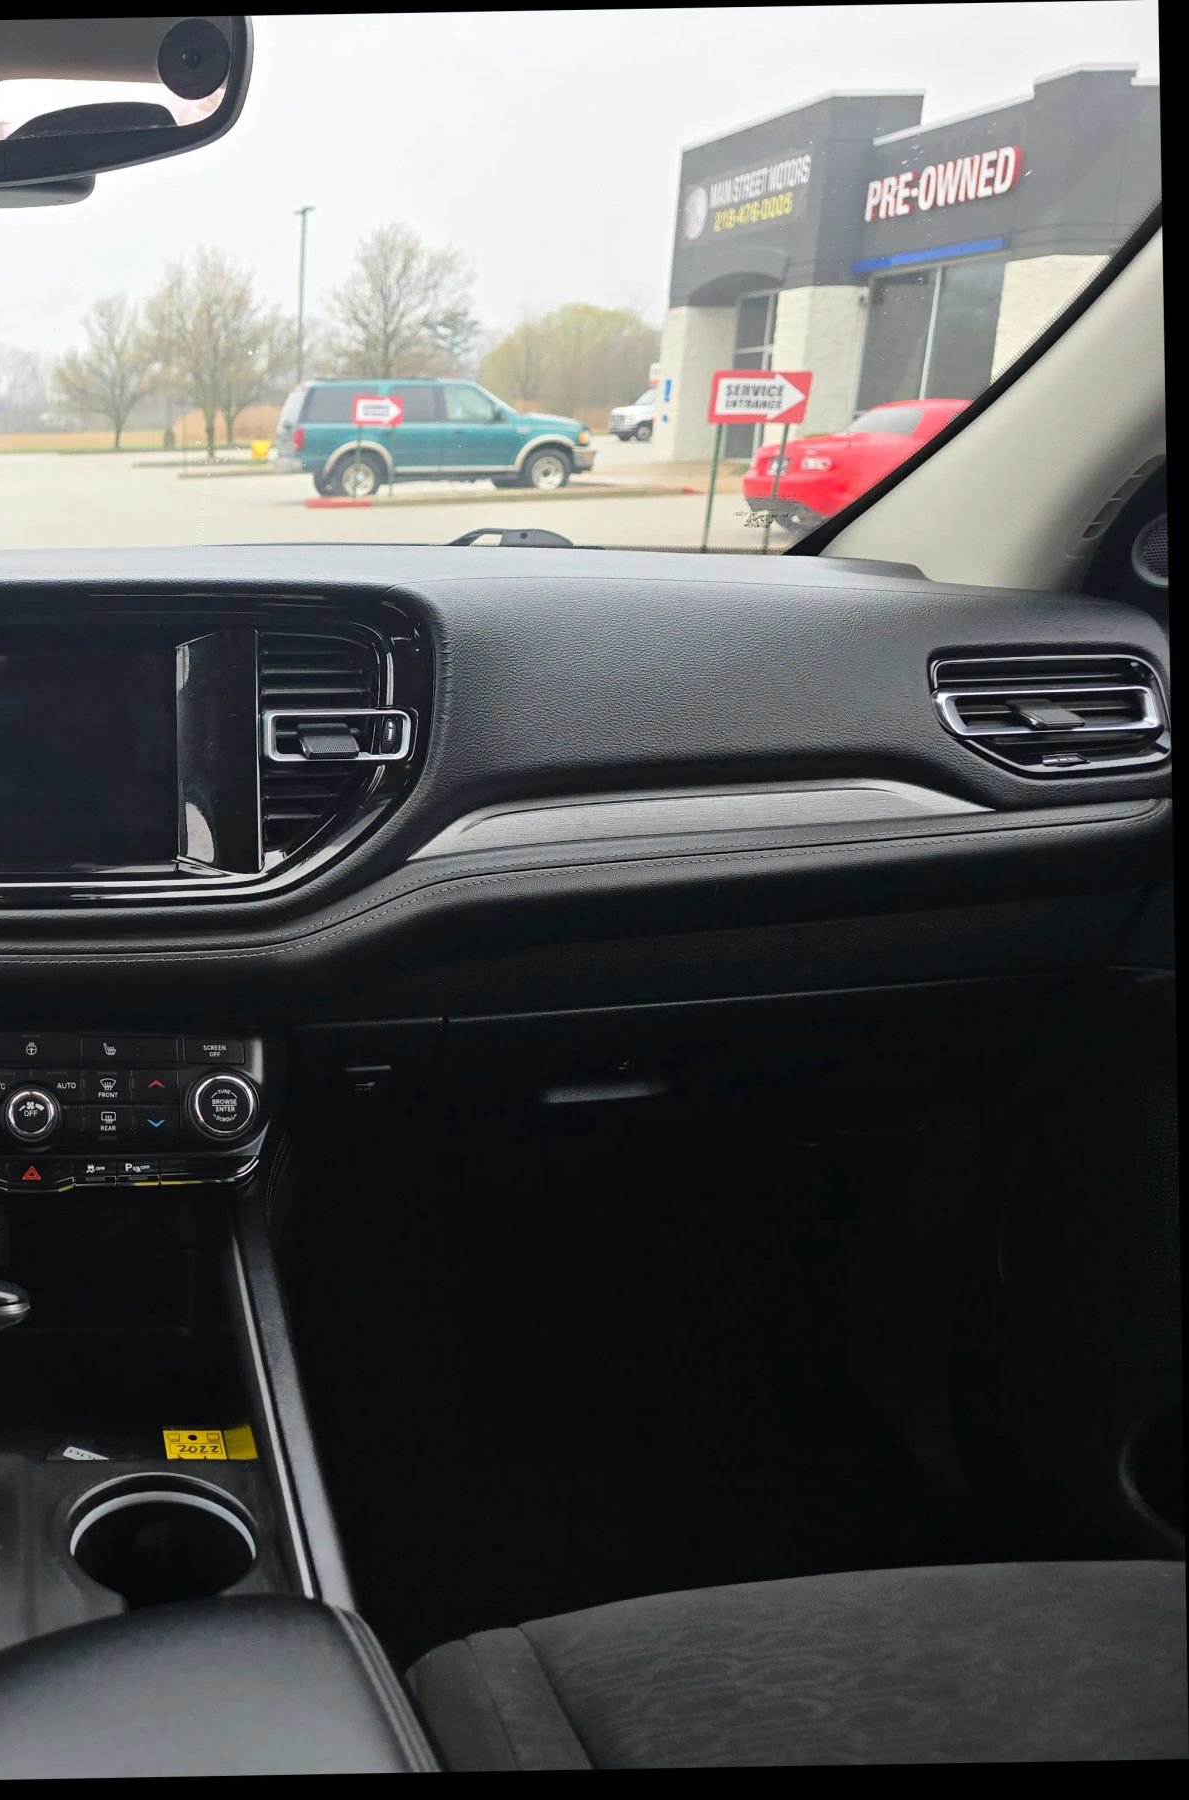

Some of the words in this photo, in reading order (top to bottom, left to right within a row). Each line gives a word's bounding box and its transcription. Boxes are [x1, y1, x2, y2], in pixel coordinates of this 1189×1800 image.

[732, 166, 769, 203] STREET
[767, 154, 812, 193] MOTORS
[864, 146, 1019, 222] PRE-OWNED
[725, 383, 785, 397] SERVICE
[57, 1082, 77, 1090] AUTO
[23, 1109, 38, 1117] OFF
[216, 1114, 236, 1122] SCROLL
[125, 1163, 133, 1172] P
[176, 1444, 219, 1453] 2022
